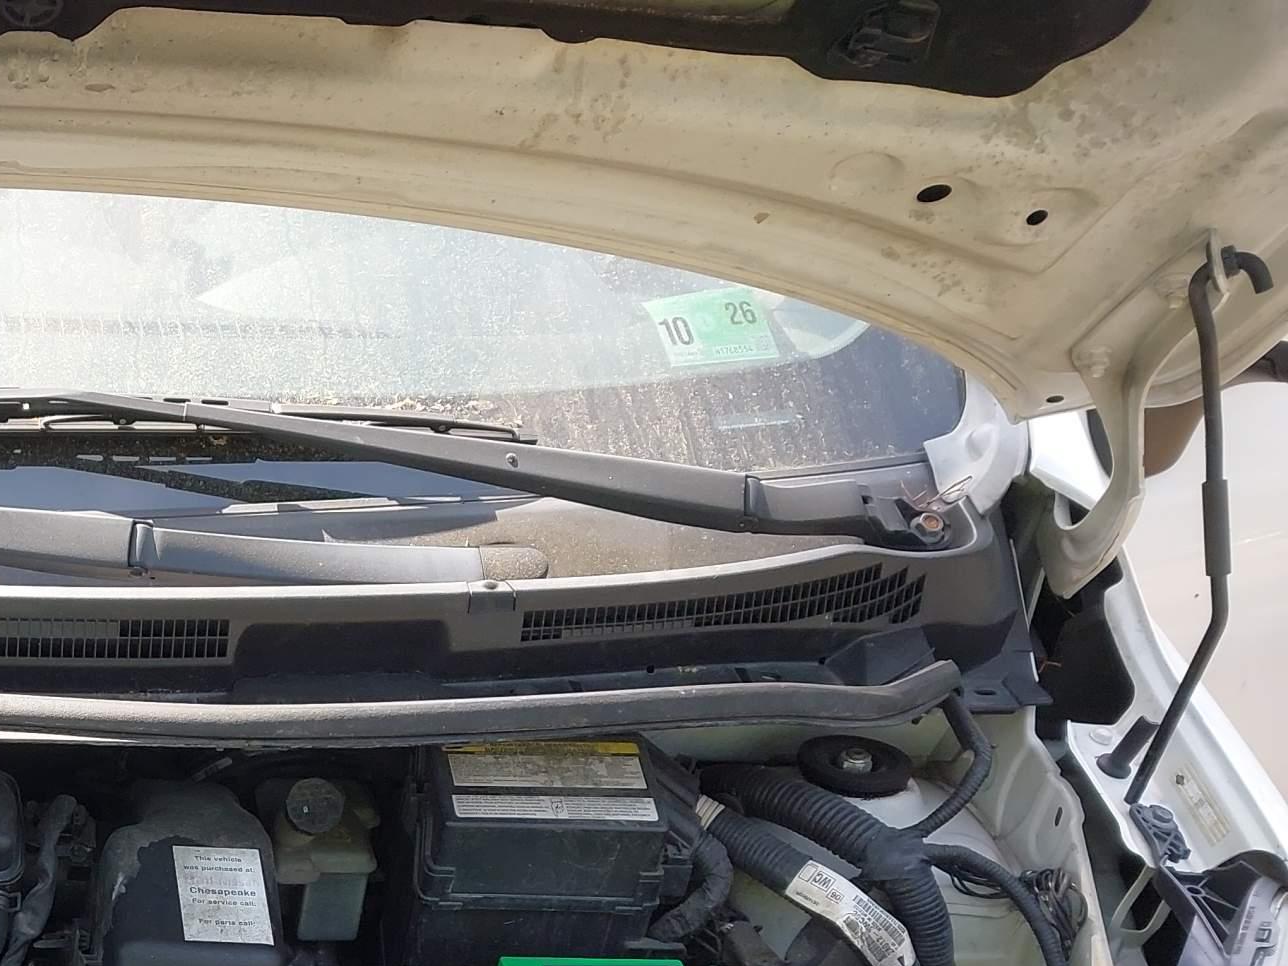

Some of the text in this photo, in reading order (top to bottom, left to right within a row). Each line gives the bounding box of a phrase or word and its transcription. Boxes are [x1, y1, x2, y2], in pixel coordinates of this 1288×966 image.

[724, 301, 758, 325] 26
[658, 316, 694, 346] 10
[812, 872, 832, 889] WC
[189, 886, 257, 897] Chesapeake
[208, 898, 238, 906] service
